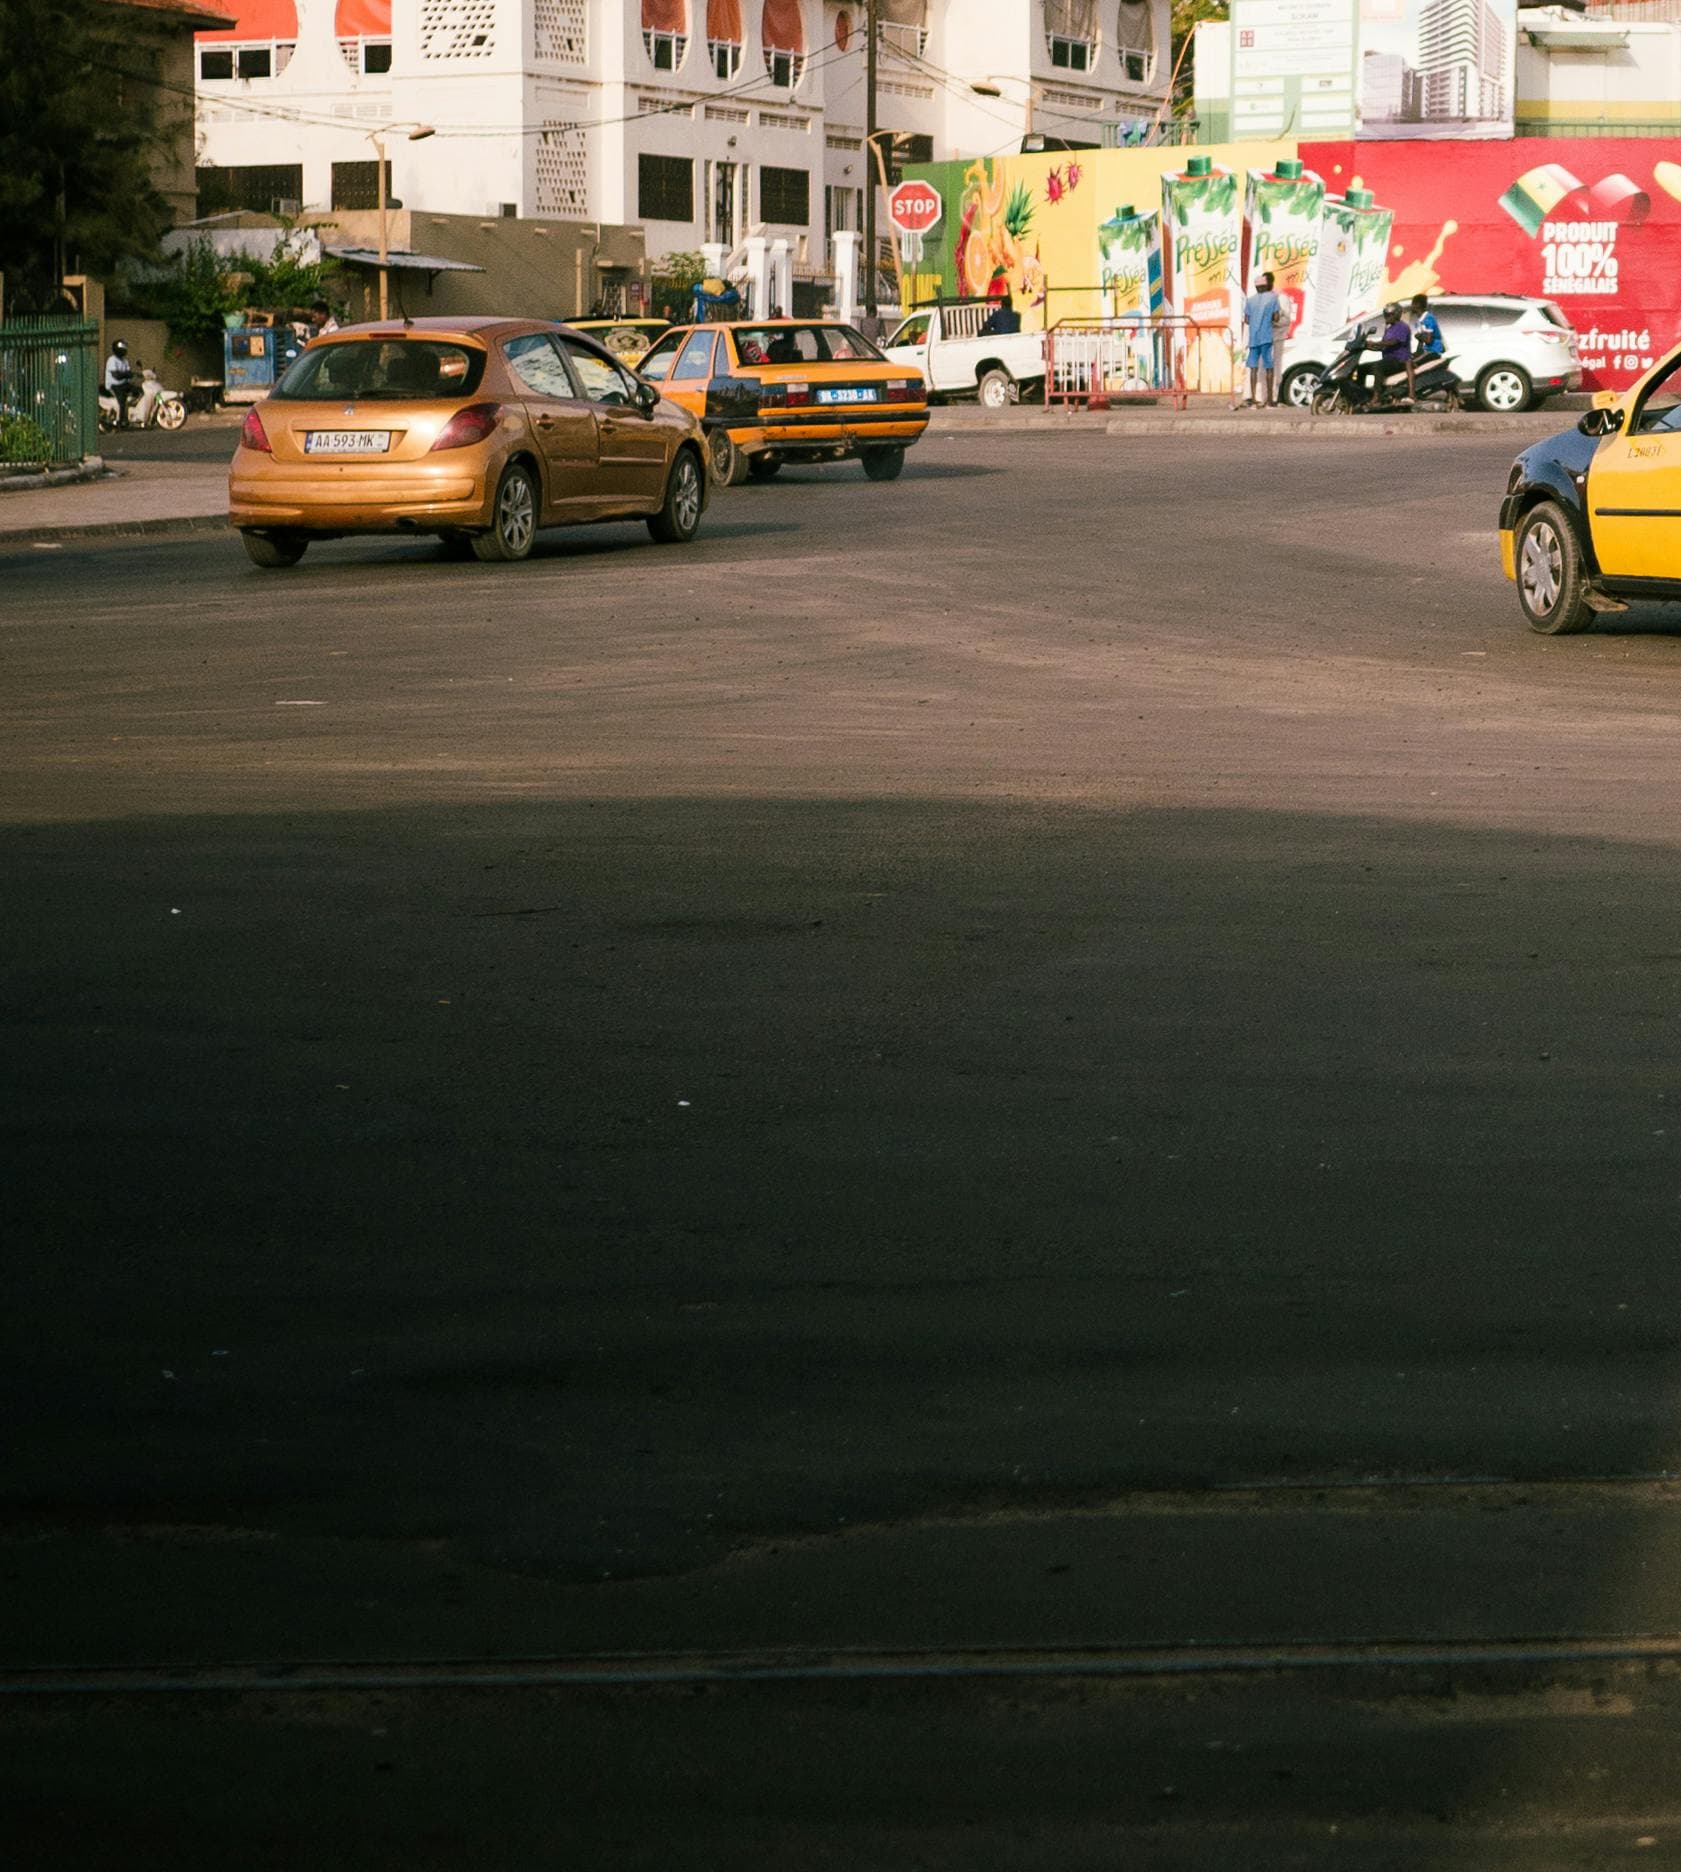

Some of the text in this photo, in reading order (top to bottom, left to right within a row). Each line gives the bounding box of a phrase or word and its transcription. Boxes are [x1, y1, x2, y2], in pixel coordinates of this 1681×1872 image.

[895, 199, 935, 215] STOP
[1543, 222, 1618, 242] PRODUIT
[1541, 243, 1618, 277] 100%
[1578, 328, 1650, 351] zfruité
[334, 434, 356, 447] 593
[358, 434, 374, 447] MK
